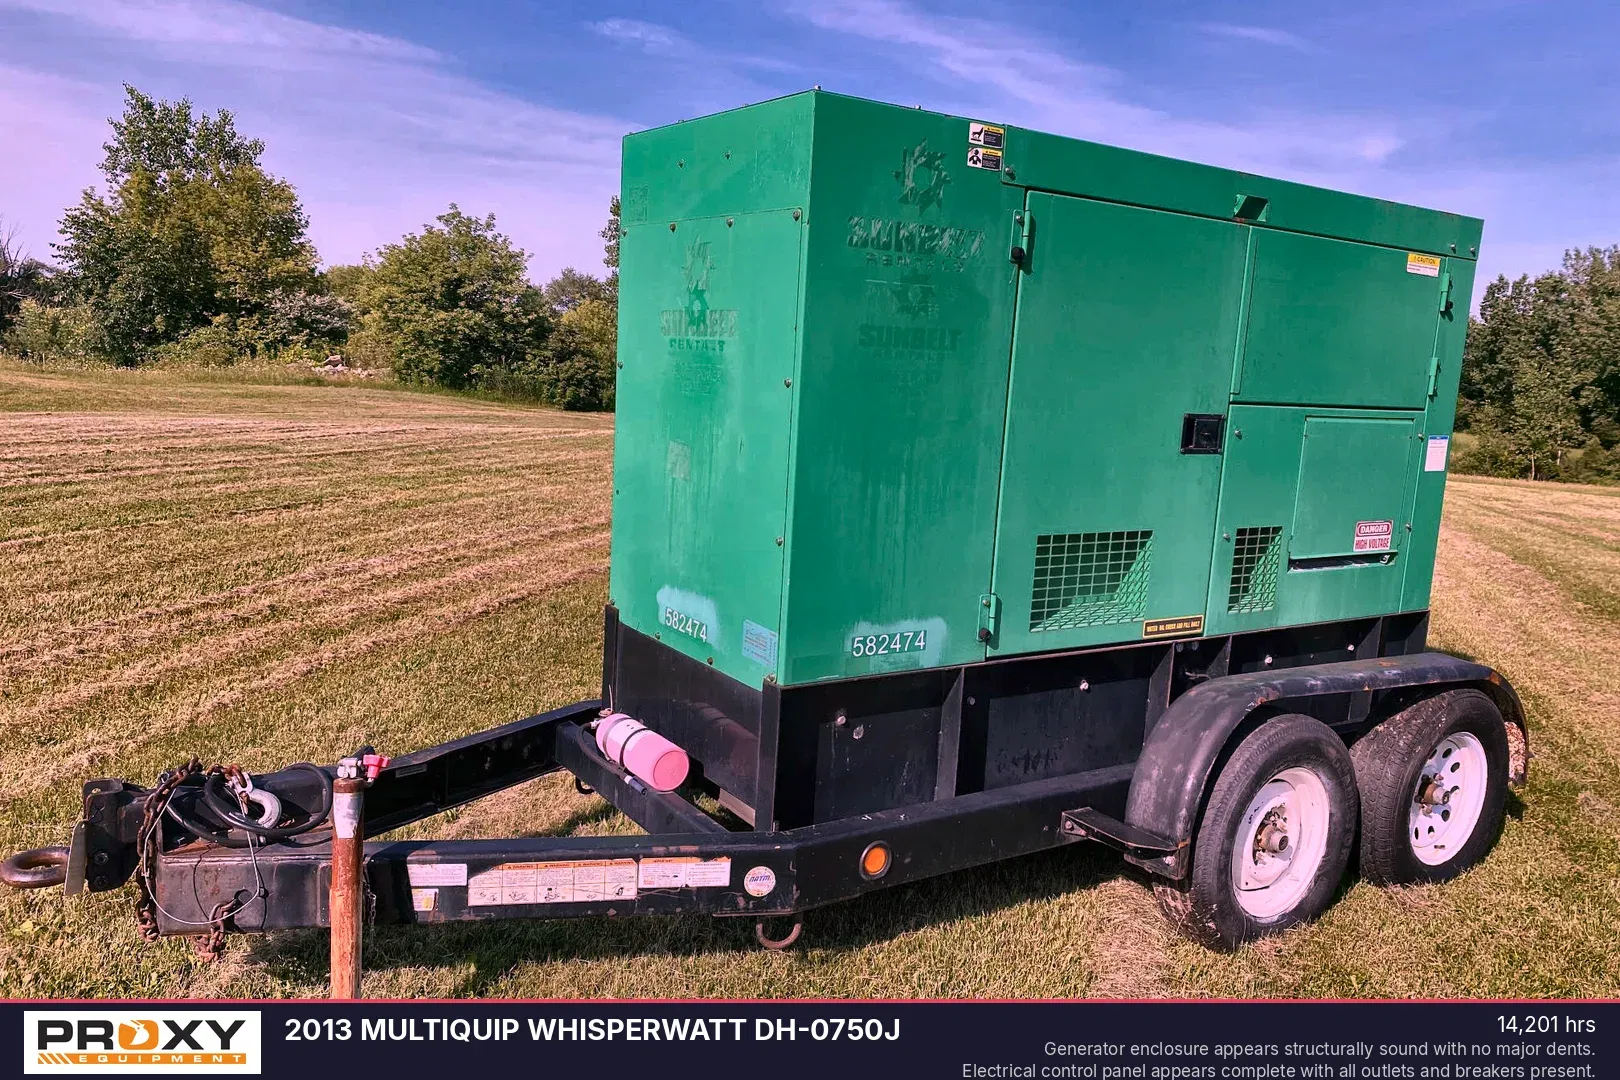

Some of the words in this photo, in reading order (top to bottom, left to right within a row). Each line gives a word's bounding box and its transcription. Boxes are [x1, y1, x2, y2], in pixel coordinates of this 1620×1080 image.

[1360, 524, 1388, 534] DANGER
[1355, 539, 1368, 549] HIGH
[1369, 538, 1389, 548] VOLTAGE
[665, 608, 708, 643] 582474
[852, 630, 926, 657] 582474
